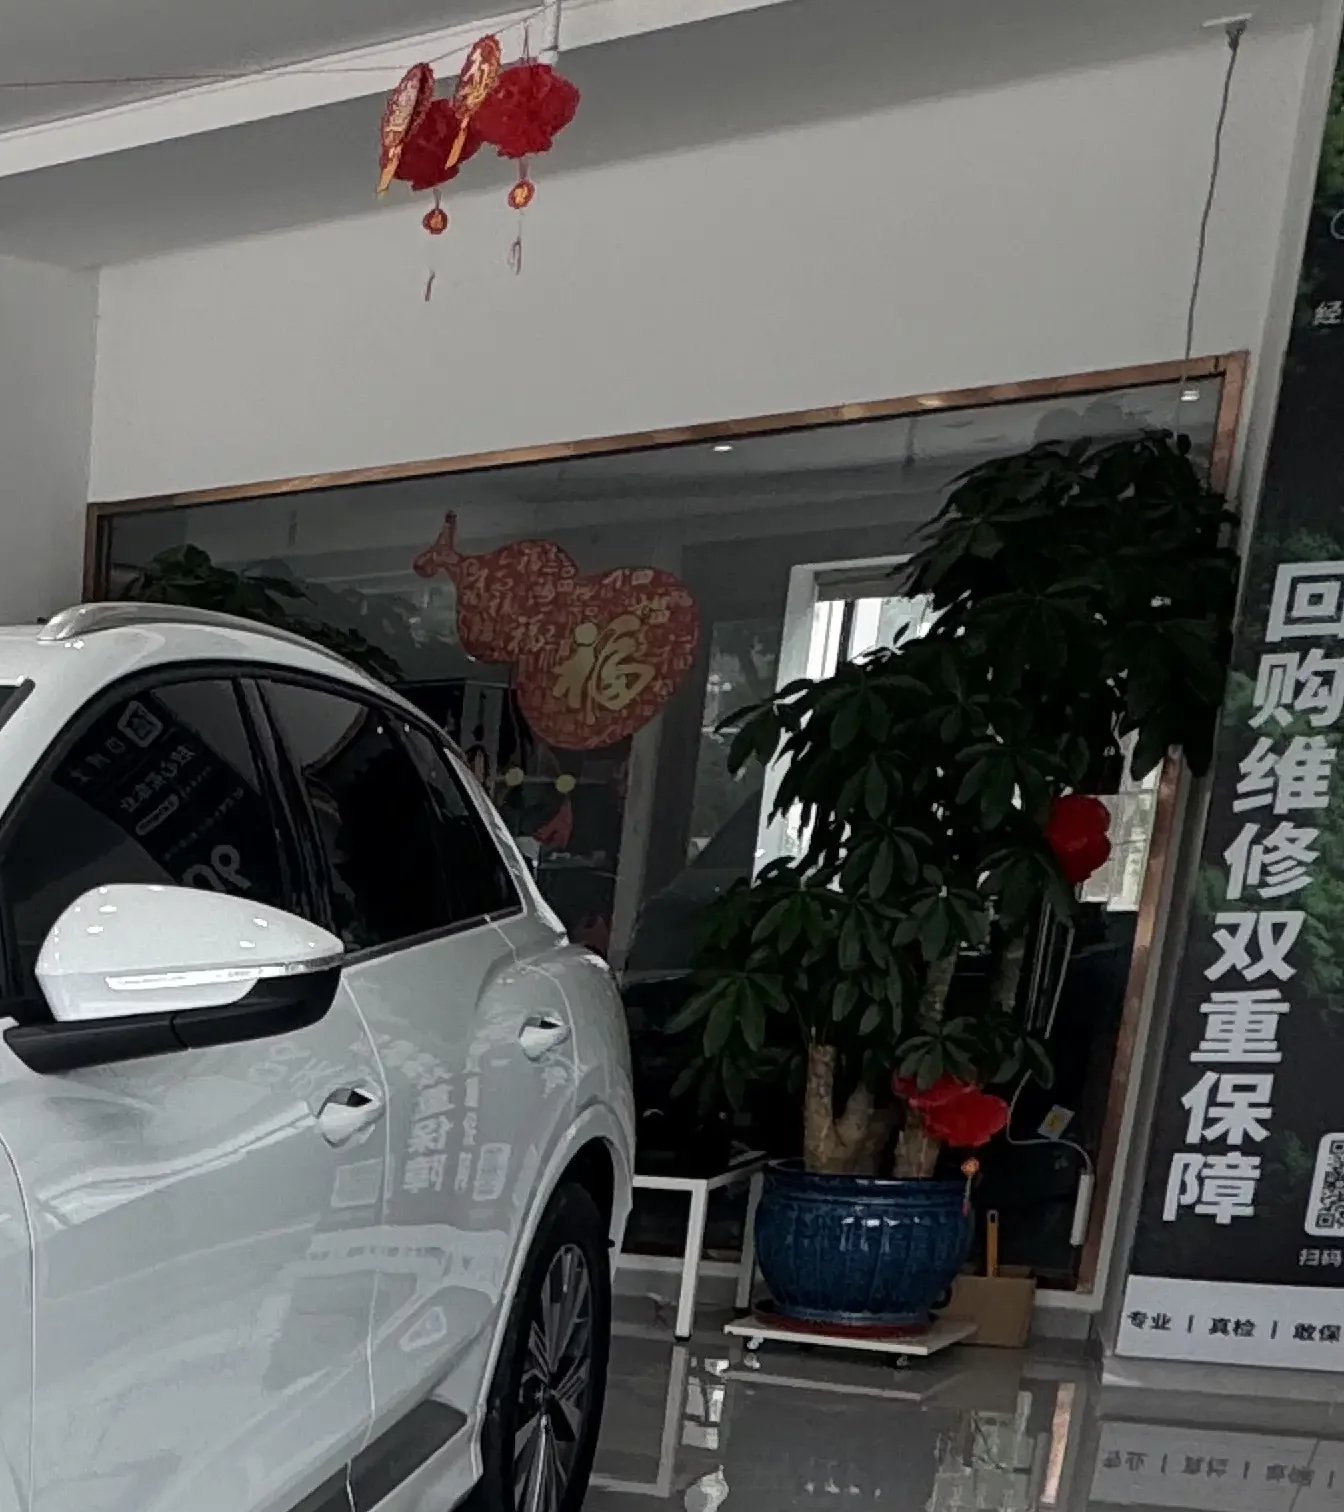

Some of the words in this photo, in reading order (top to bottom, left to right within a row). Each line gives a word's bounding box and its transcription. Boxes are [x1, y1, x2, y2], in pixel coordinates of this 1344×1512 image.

[1162, 560, 1344, 1226] 回购维修双重保障
